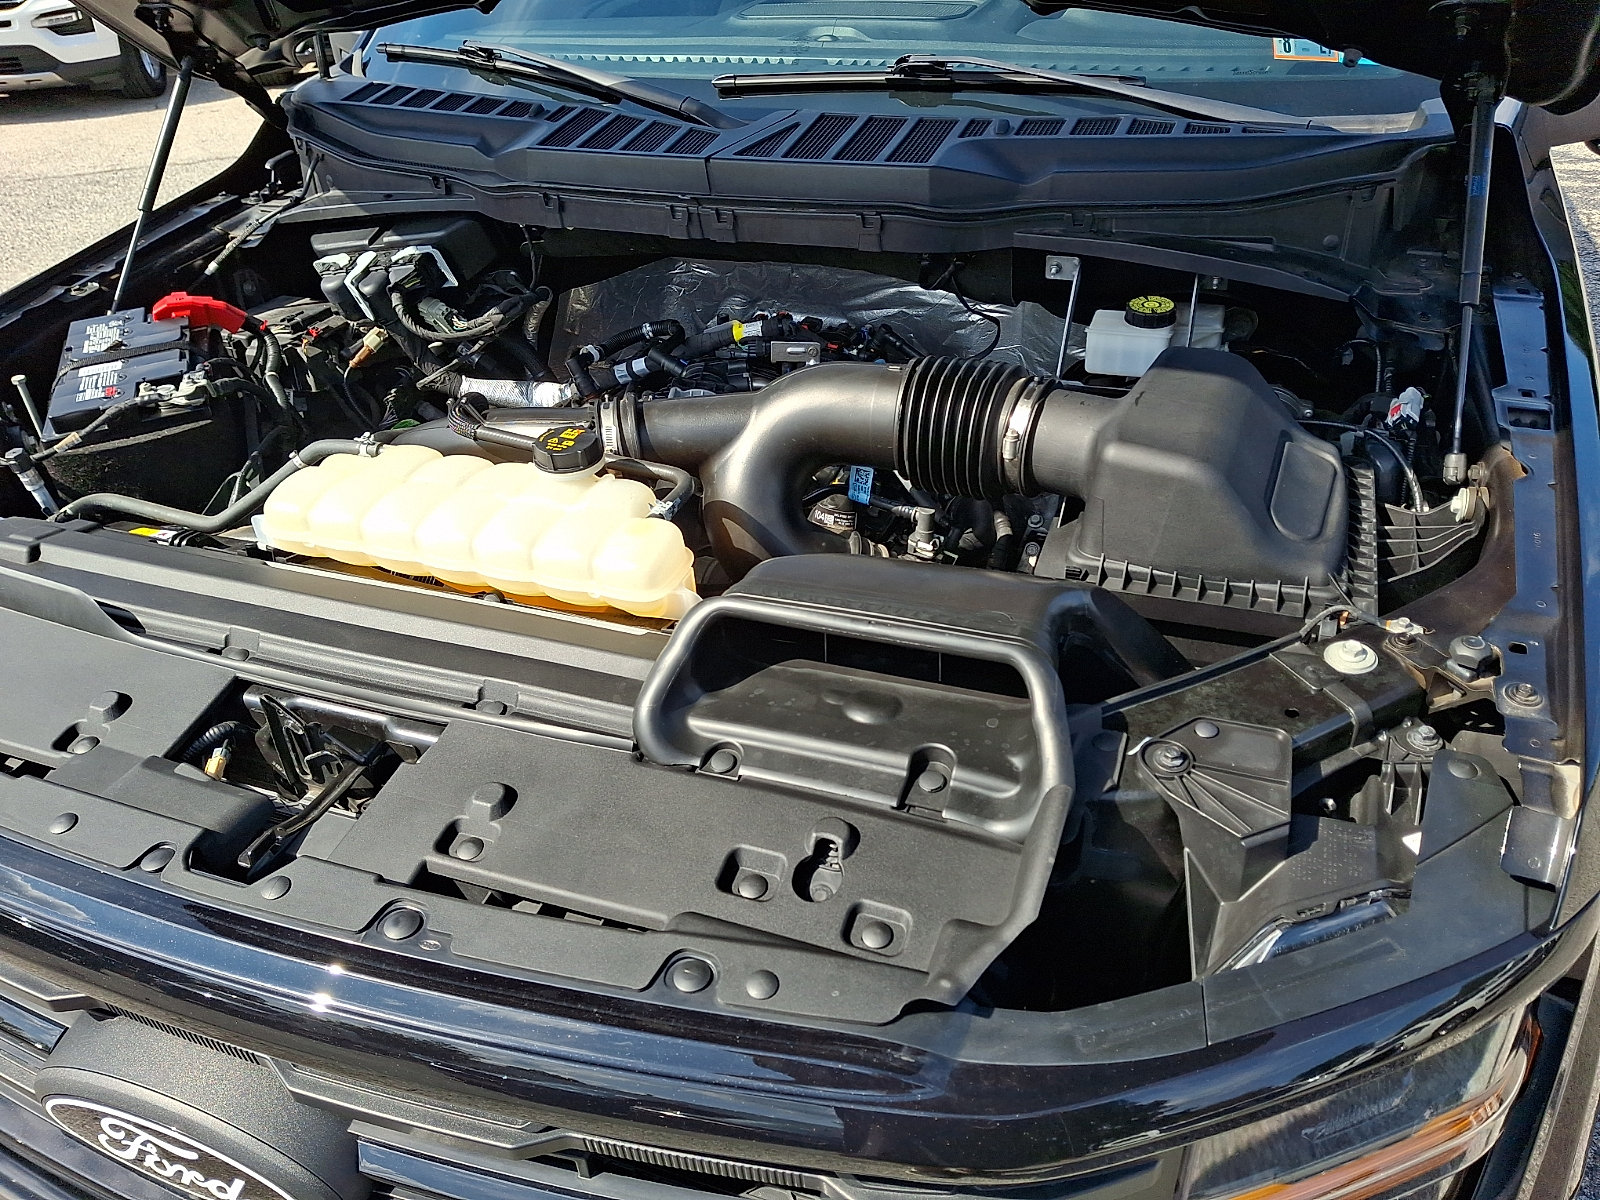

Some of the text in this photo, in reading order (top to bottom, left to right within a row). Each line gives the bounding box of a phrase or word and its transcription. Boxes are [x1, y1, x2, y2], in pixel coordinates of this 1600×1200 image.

[1282, 38, 1292, 53] 8
[814, 509, 825, 521] 104
[98, 1117, 249, 1200] Ford
